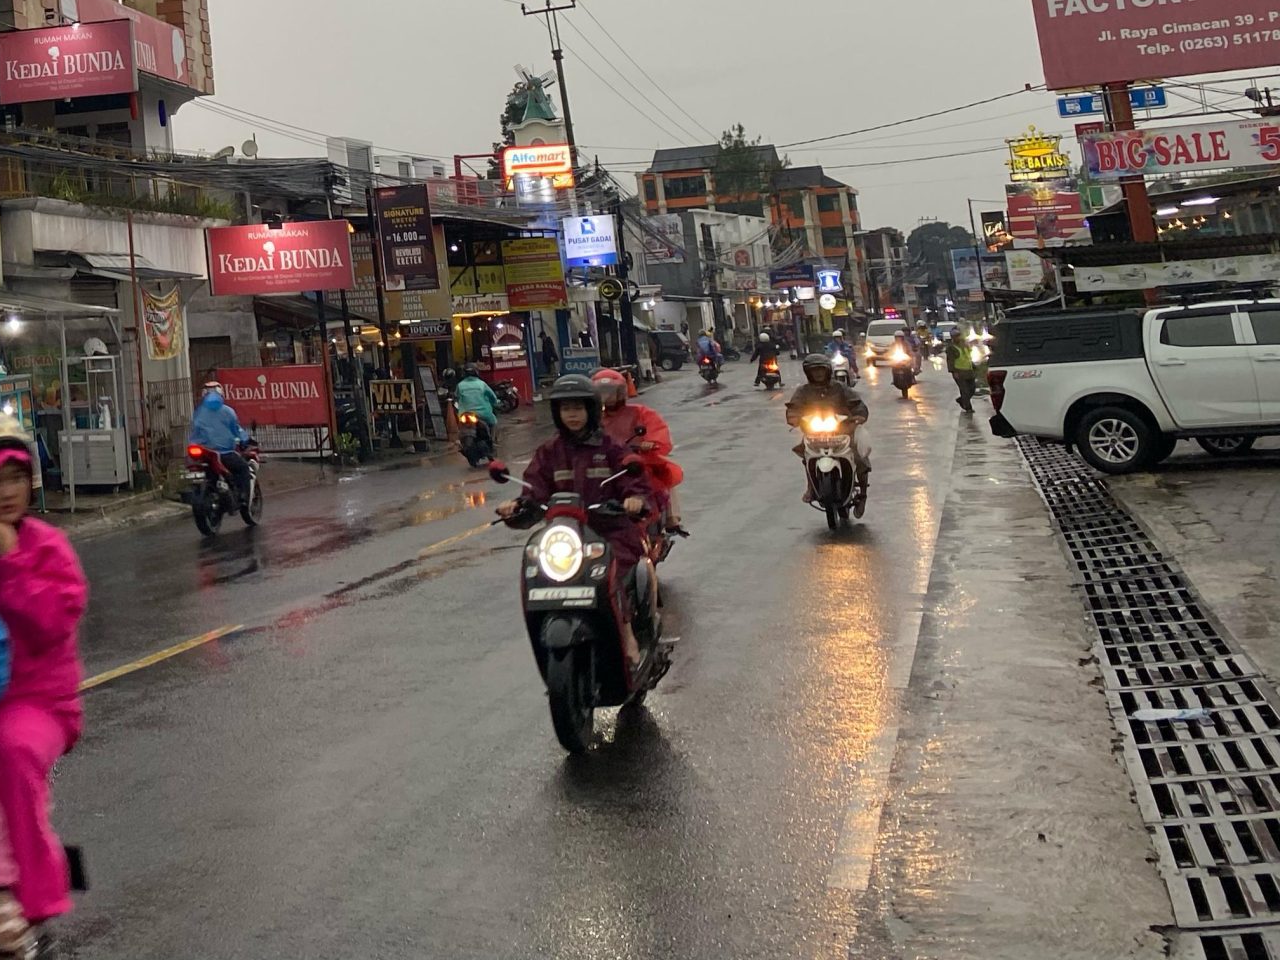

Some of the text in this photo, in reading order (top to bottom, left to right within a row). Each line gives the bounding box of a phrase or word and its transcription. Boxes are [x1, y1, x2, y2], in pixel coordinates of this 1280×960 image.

[1098, 31, 1116, 42] Jl.
[1120, 27, 1158, 40] Raya
[1162, 19, 1231, 35] Cimacan
[1234, 14, 1254, 26] 39
[33, 32, 93, 45] RUMAH MAKAN
[1136, 43, 1175, 55] Telp.
[1179, 35, 1229, 53] (0263)
[63, 50, 125, 75] BUNDA
[134, 40, 157, 72] UNDA
[511, 150, 567, 164] Alfamart
[1096, 139, 1148, 172] BIG
[1154, 130, 1231, 166] SALE
[383, 208, 424, 218] SIGNATURE
[247, 229, 309, 240] RUMAH MAKAN
[392, 231, 418, 242] 16.000
[568, 235, 612, 245] PUSAT GADAI
[279, 247, 344, 271] BUNDA
[396, 256, 423, 266] KRETEK
[270, 381, 320, 400] BUNDA
[372, 383, 412, 404] VILA
